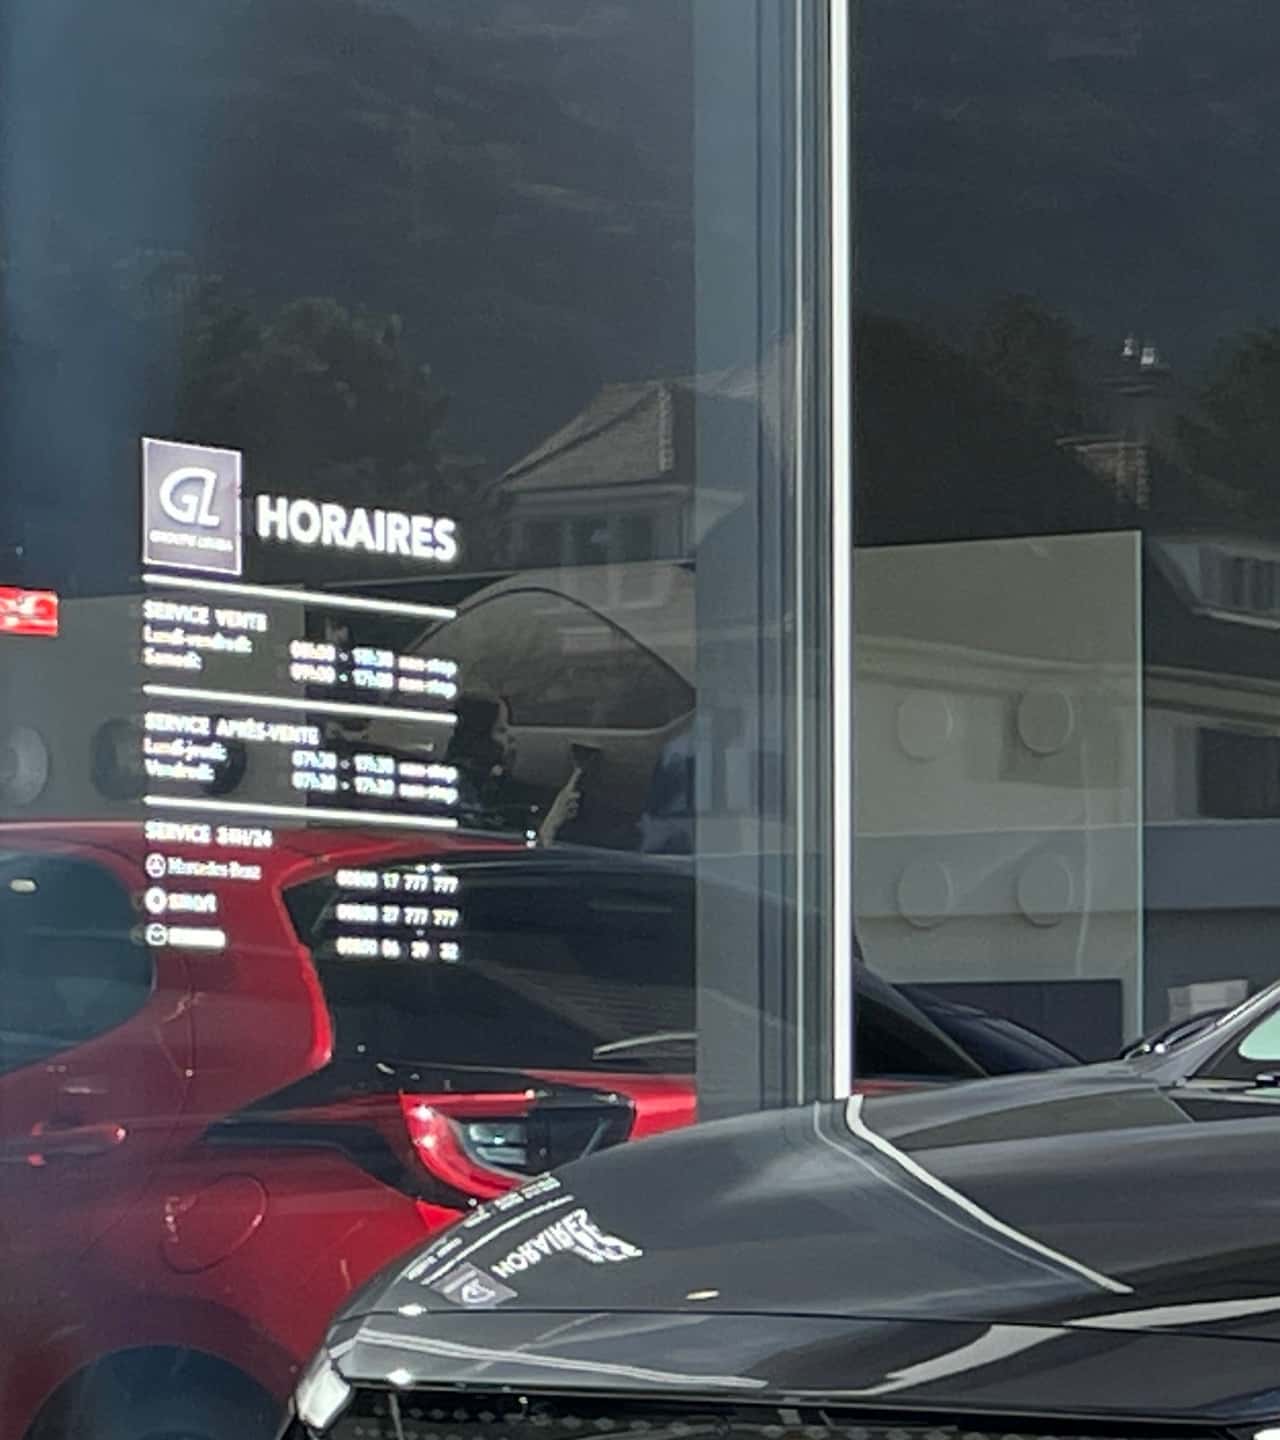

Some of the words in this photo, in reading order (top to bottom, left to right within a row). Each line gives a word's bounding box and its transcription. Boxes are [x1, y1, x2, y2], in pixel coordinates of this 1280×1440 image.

[256, 494, 458, 563] HORAIRES
[143, 600, 210, 626] SERVICE
[214, 609, 267, 632] VENTE
[144, 712, 210, 736] SERVICE
[215, 717, 320, 746] APRÈS-VENTE
[144, 821, 213, 844] SERVICE
[168, 857, 262, 881] Mercedes-Benz
